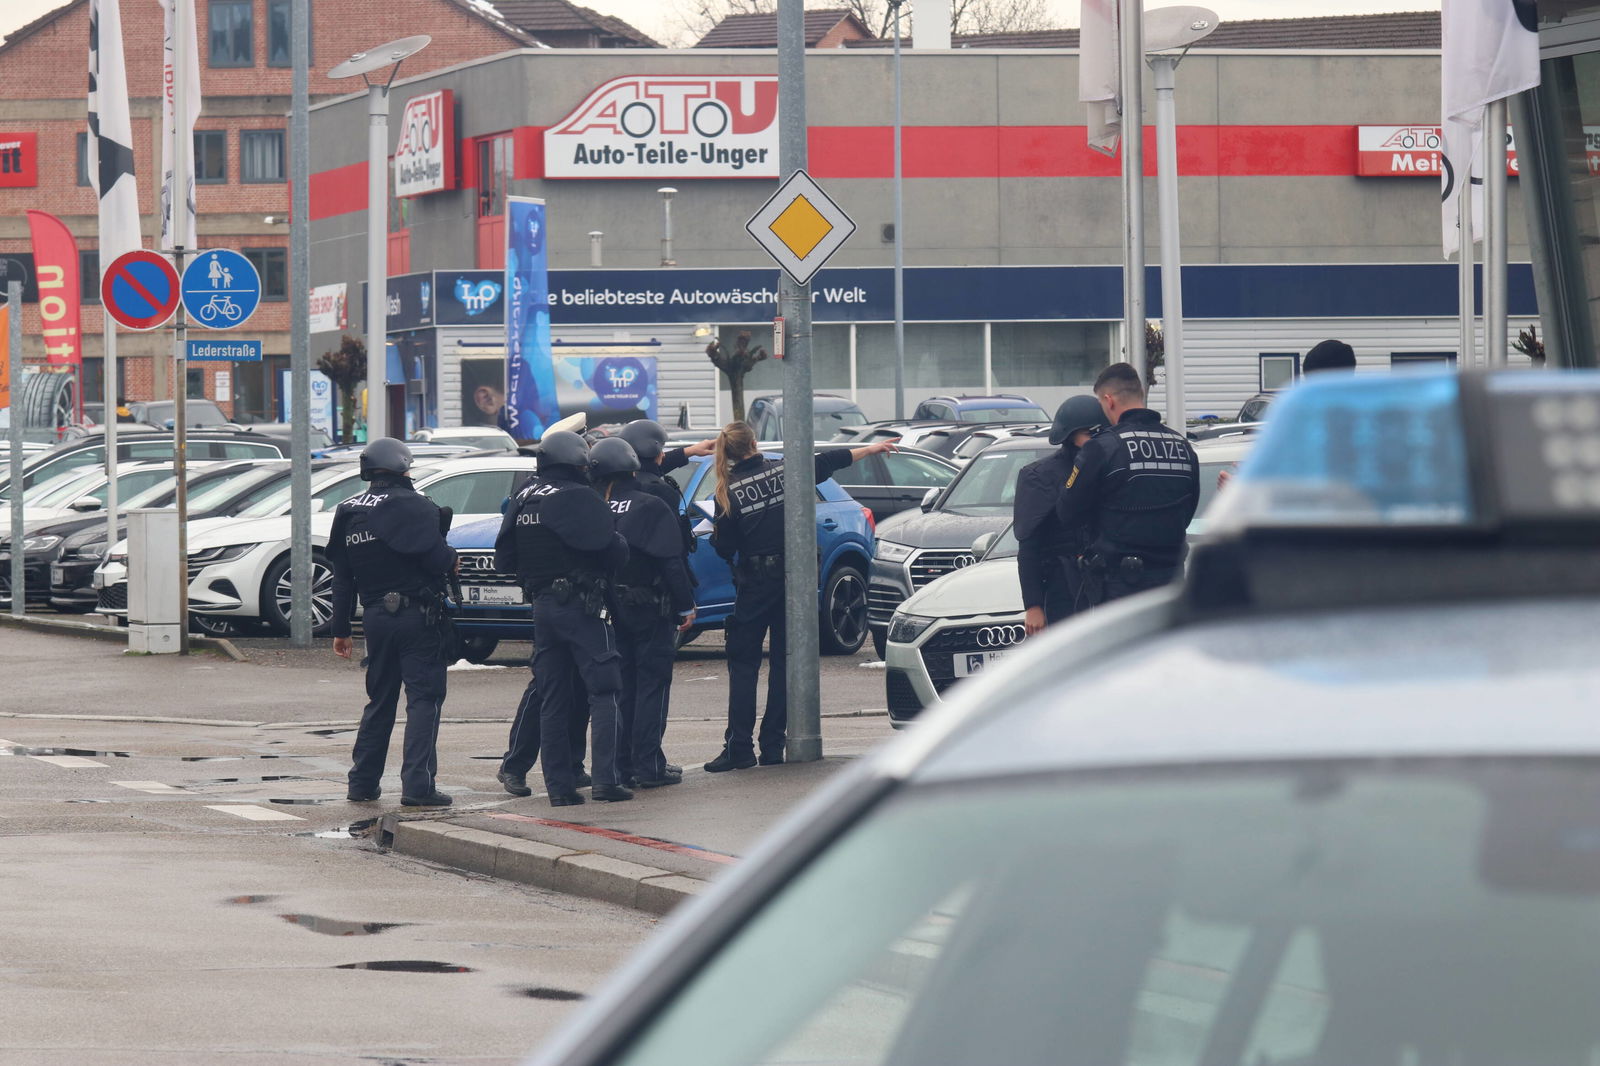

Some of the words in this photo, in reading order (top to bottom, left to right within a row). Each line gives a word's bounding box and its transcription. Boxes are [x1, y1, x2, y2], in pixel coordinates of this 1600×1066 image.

[573, 140, 769, 170] Auto-Teile-Unger
[561, 288, 665, 306] beliebteste
[823, 286, 867, 304] Welt
[192, 343, 256, 357] Lederstraße
[1126, 439, 1192, 460] POLIZEI
